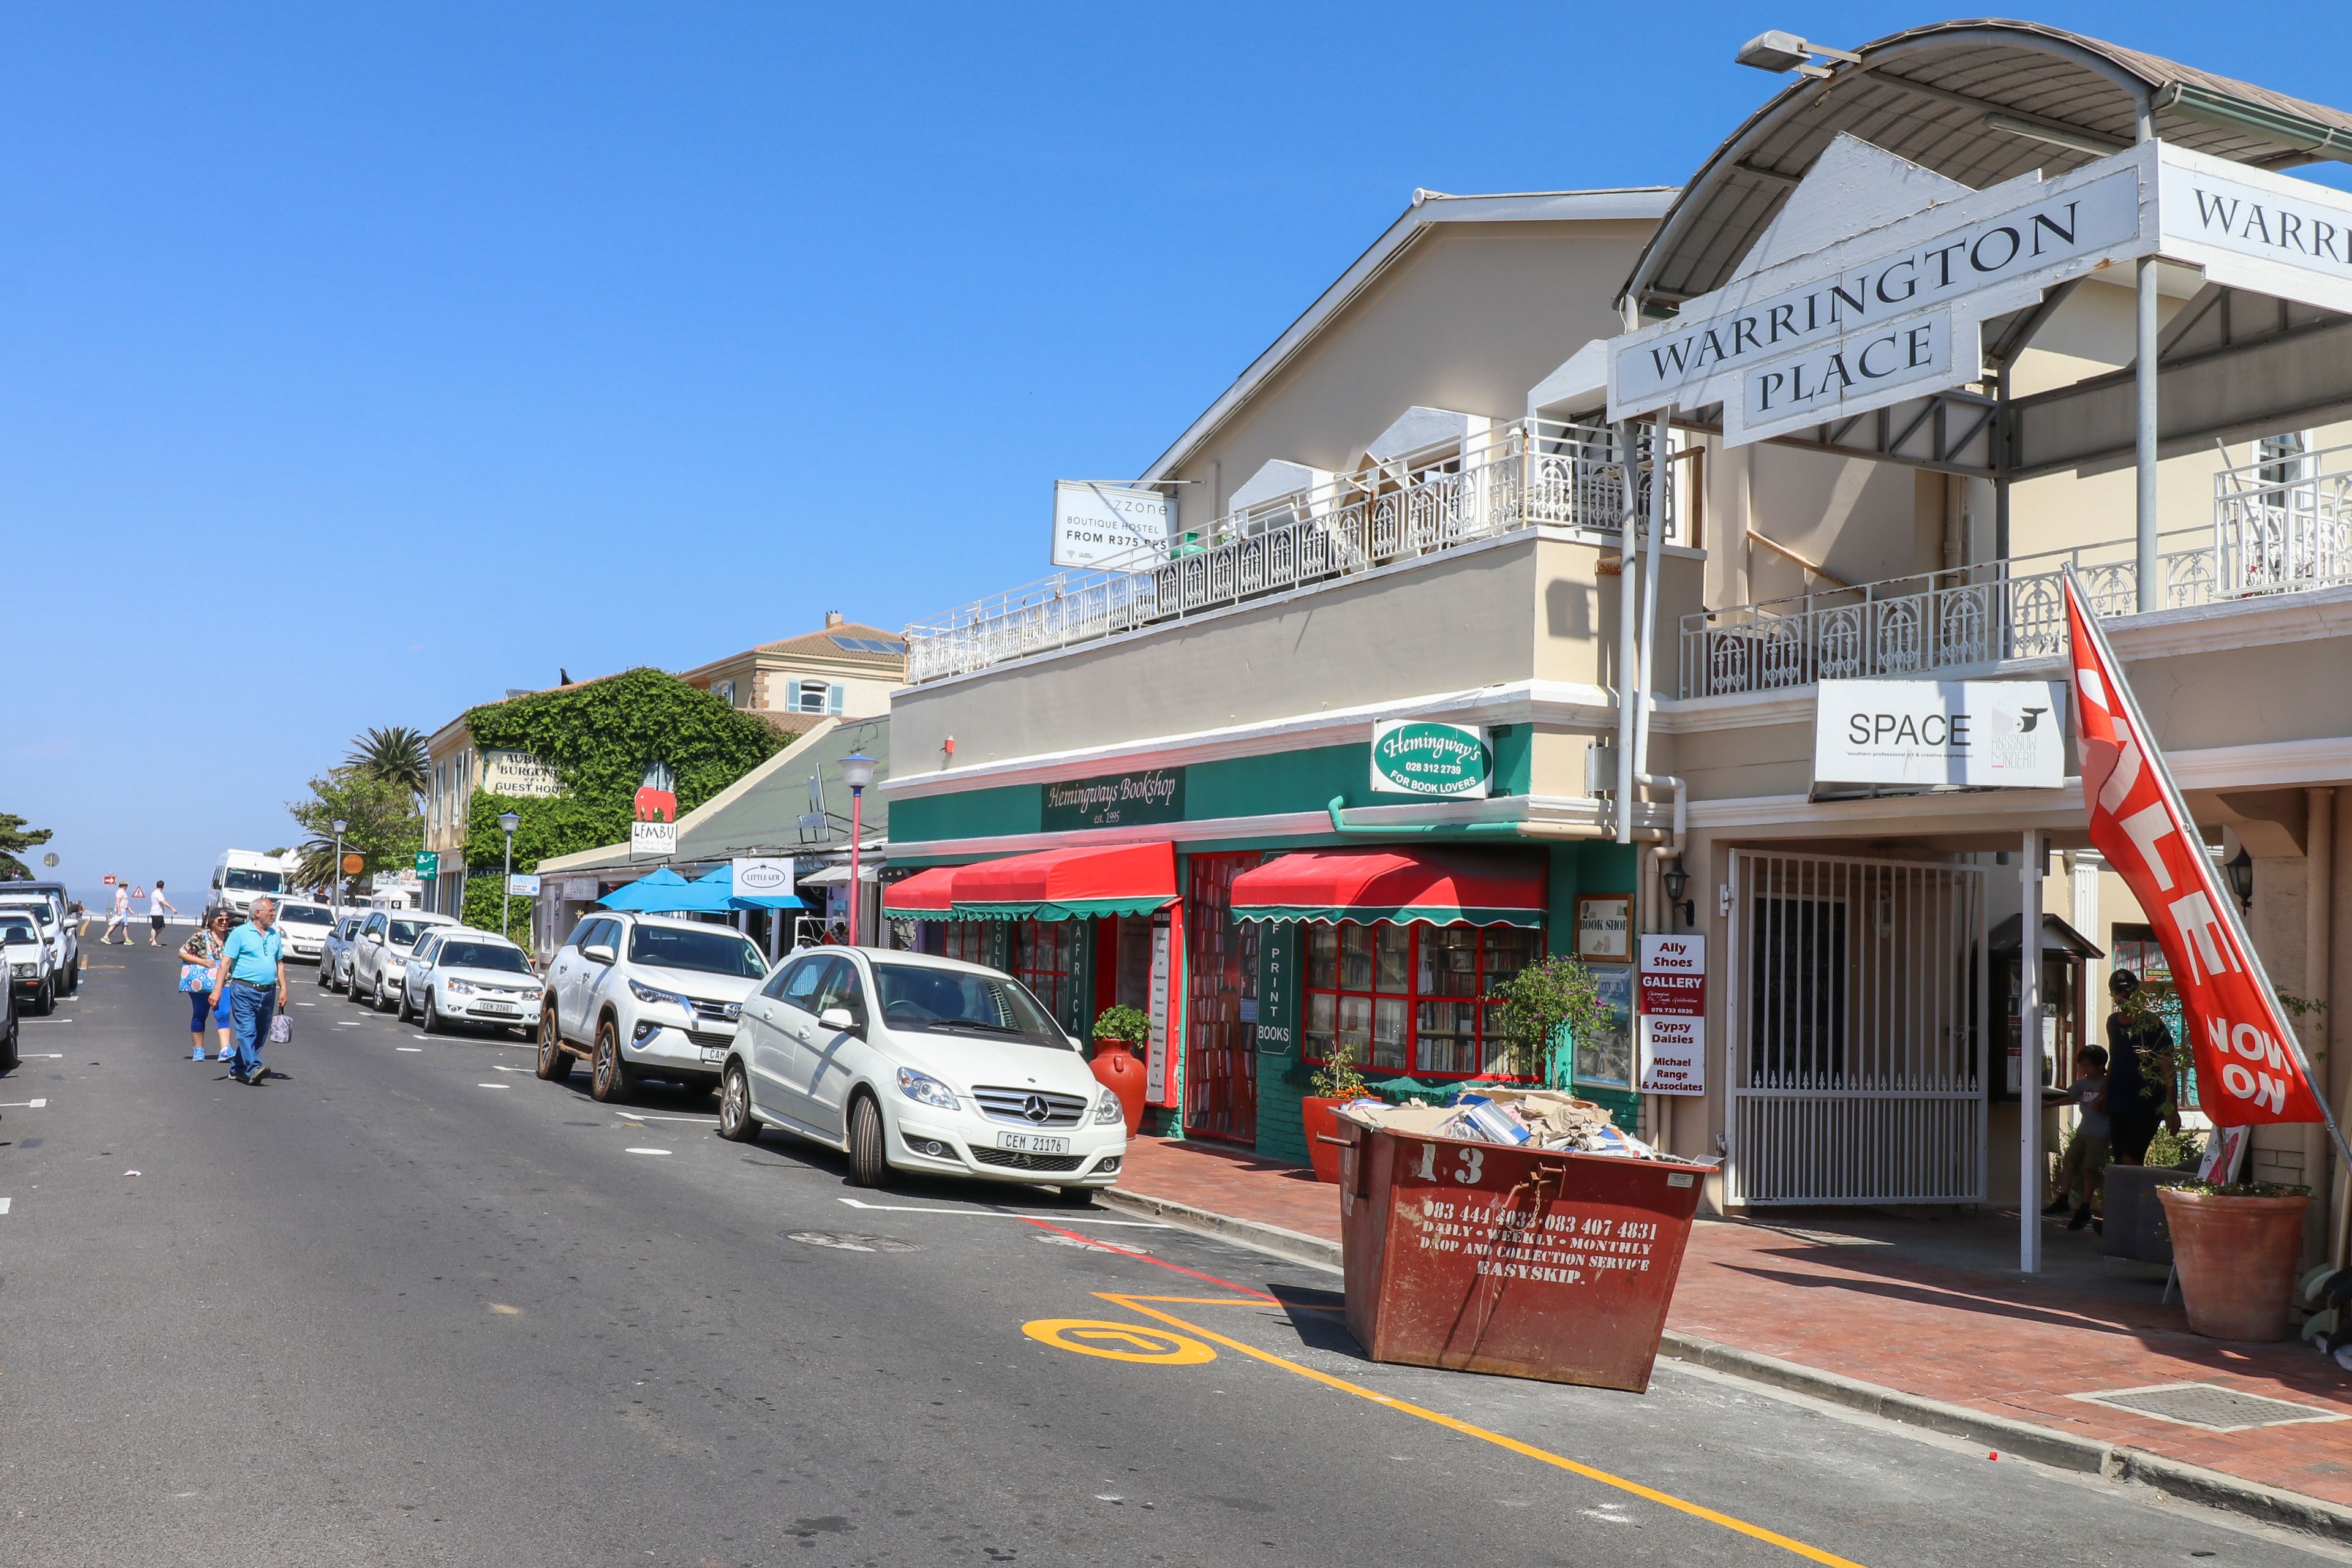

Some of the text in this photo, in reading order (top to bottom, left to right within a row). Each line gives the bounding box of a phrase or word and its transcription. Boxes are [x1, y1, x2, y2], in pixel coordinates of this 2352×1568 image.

[1649, 199, 2081, 380] WARRINGTON
[1757, 321, 1933, 413] PLACE
[1067, 516, 1159, 534] BOUTIQUE HOSTEL
[1066, 530, 1102, 543] FROM
[1109, 535, 1139, 546] R375
[1849, 713, 1972, 747] SPACE
[1383, 726, 1481, 764] Hemingway's
[1405, 761, 1461, 775] 028 312 2739
[496, 782, 532, 792] GUEST
[1390, 769, 1476, 793] FOR BOOK LOVERS
[1048, 770, 1175, 814] Hemingways Bookshop
[1094, 811, 1120, 824] est. 1995
[634, 824, 674, 840] LEMBU
[1580, 919, 1604, 930] BOOK
[1659, 942, 1687, 956] Ally
[1653, 957, 1693, 968] Shoes
[1072, 925, 1081, 1031] AFRICA
[1270, 948, 1280, 1017] PRINT
[1642, 976, 1703, 989] GALLERY
[1257, 1025, 1289, 1042] BOOKS
[1654, 1021, 1691, 1033] Gypsy
[1652, 1034, 1694, 1044] Daisies
[710, 1049, 725, 1060] CAM
[1653, 1057, 1691, 1067] Michael
[1656, 1070, 1688, 1080] Range
[1642, 1081, 1703, 1091] & Associates
[2222, 1063, 2286, 1115] ON
[1006, 1134, 1062, 1153] CEM 21176
[1423, 1200, 1453, 1220] 083
[1460, 1205, 1490, 1224] 444
[1544, 1213, 1576, 1233] 083
[1581, 1218, 1613, 1236] 407
[1618, 1221, 1656, 1240] 4831
[1422, 1219, 1653, 1256] DAILY WEEKLY MONTHLY
[1419, 1235, 1651, 1272] DROP AND COLLECTION SERVICE
[1477, 1260, 1586, 1286] EASYSKIP.
